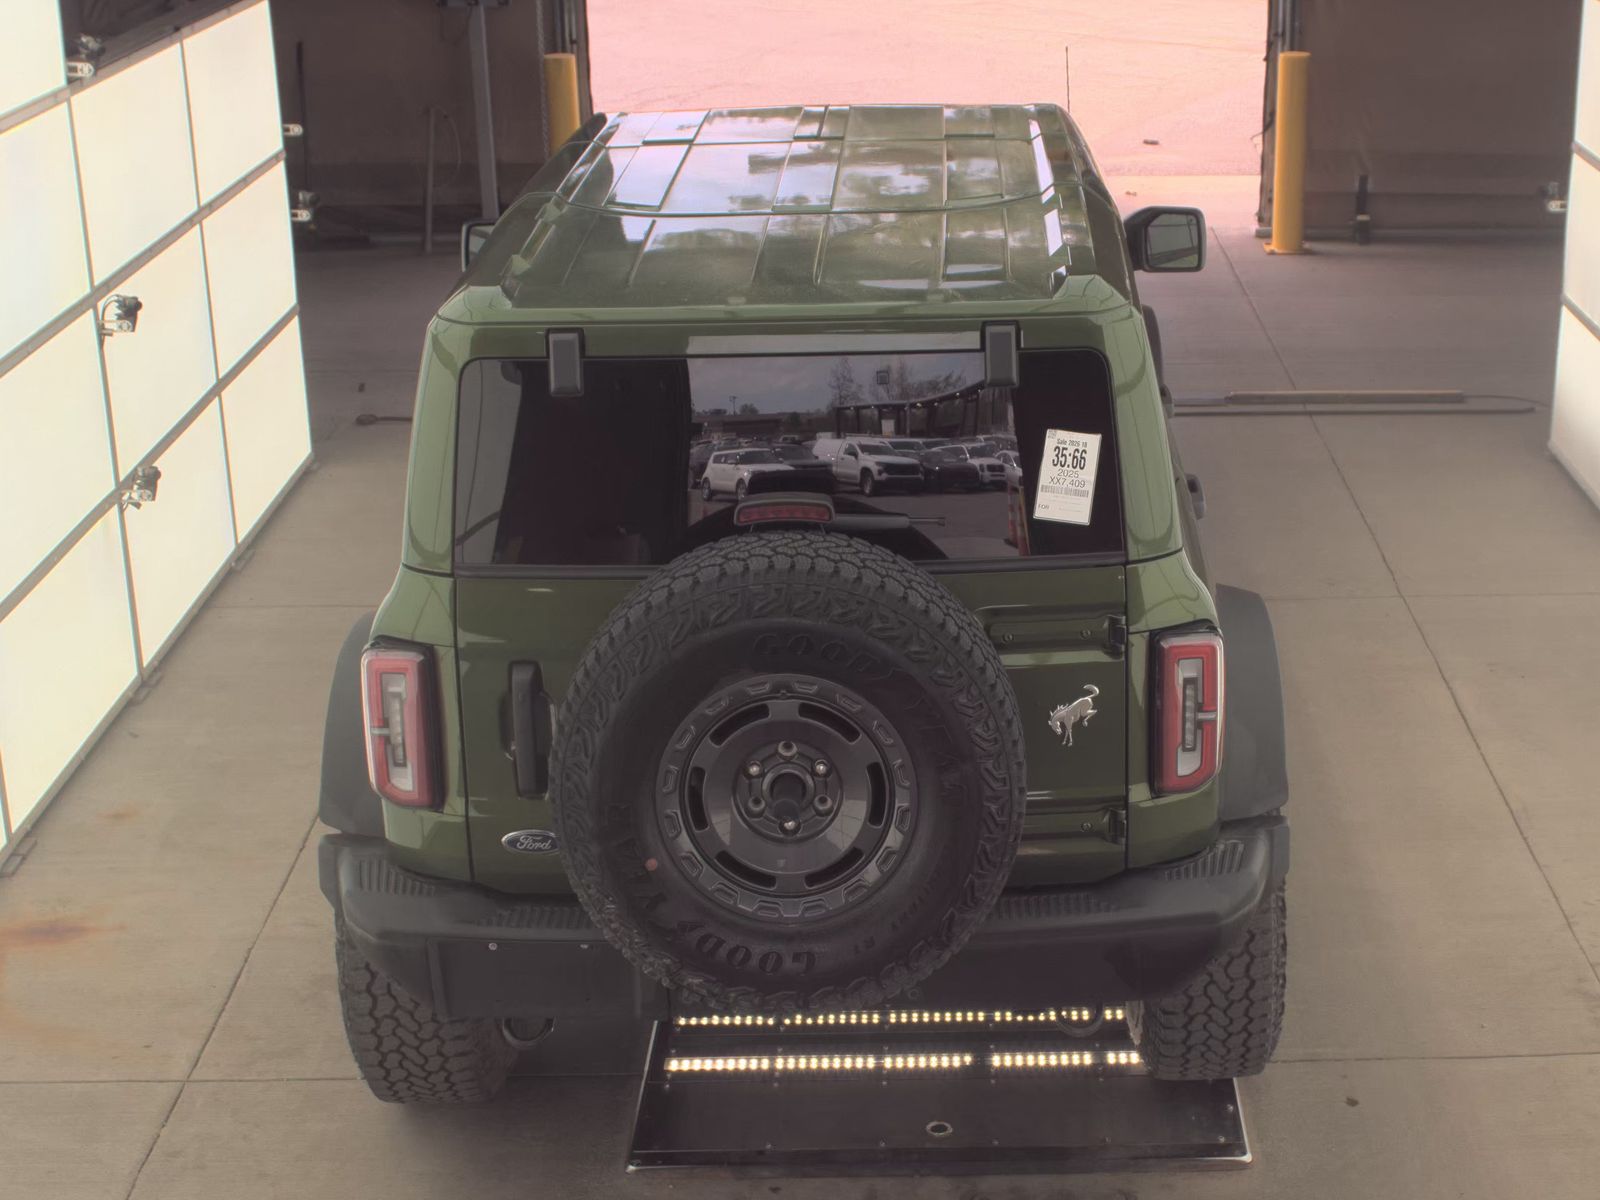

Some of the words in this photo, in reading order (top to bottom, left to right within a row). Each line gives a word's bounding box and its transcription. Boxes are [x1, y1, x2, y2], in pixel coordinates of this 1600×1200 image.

[1052, 446, 1087, 470] 35:66
[1057, 469, 1080, 478] 2025
[516, 835, 552, 850] Ford
